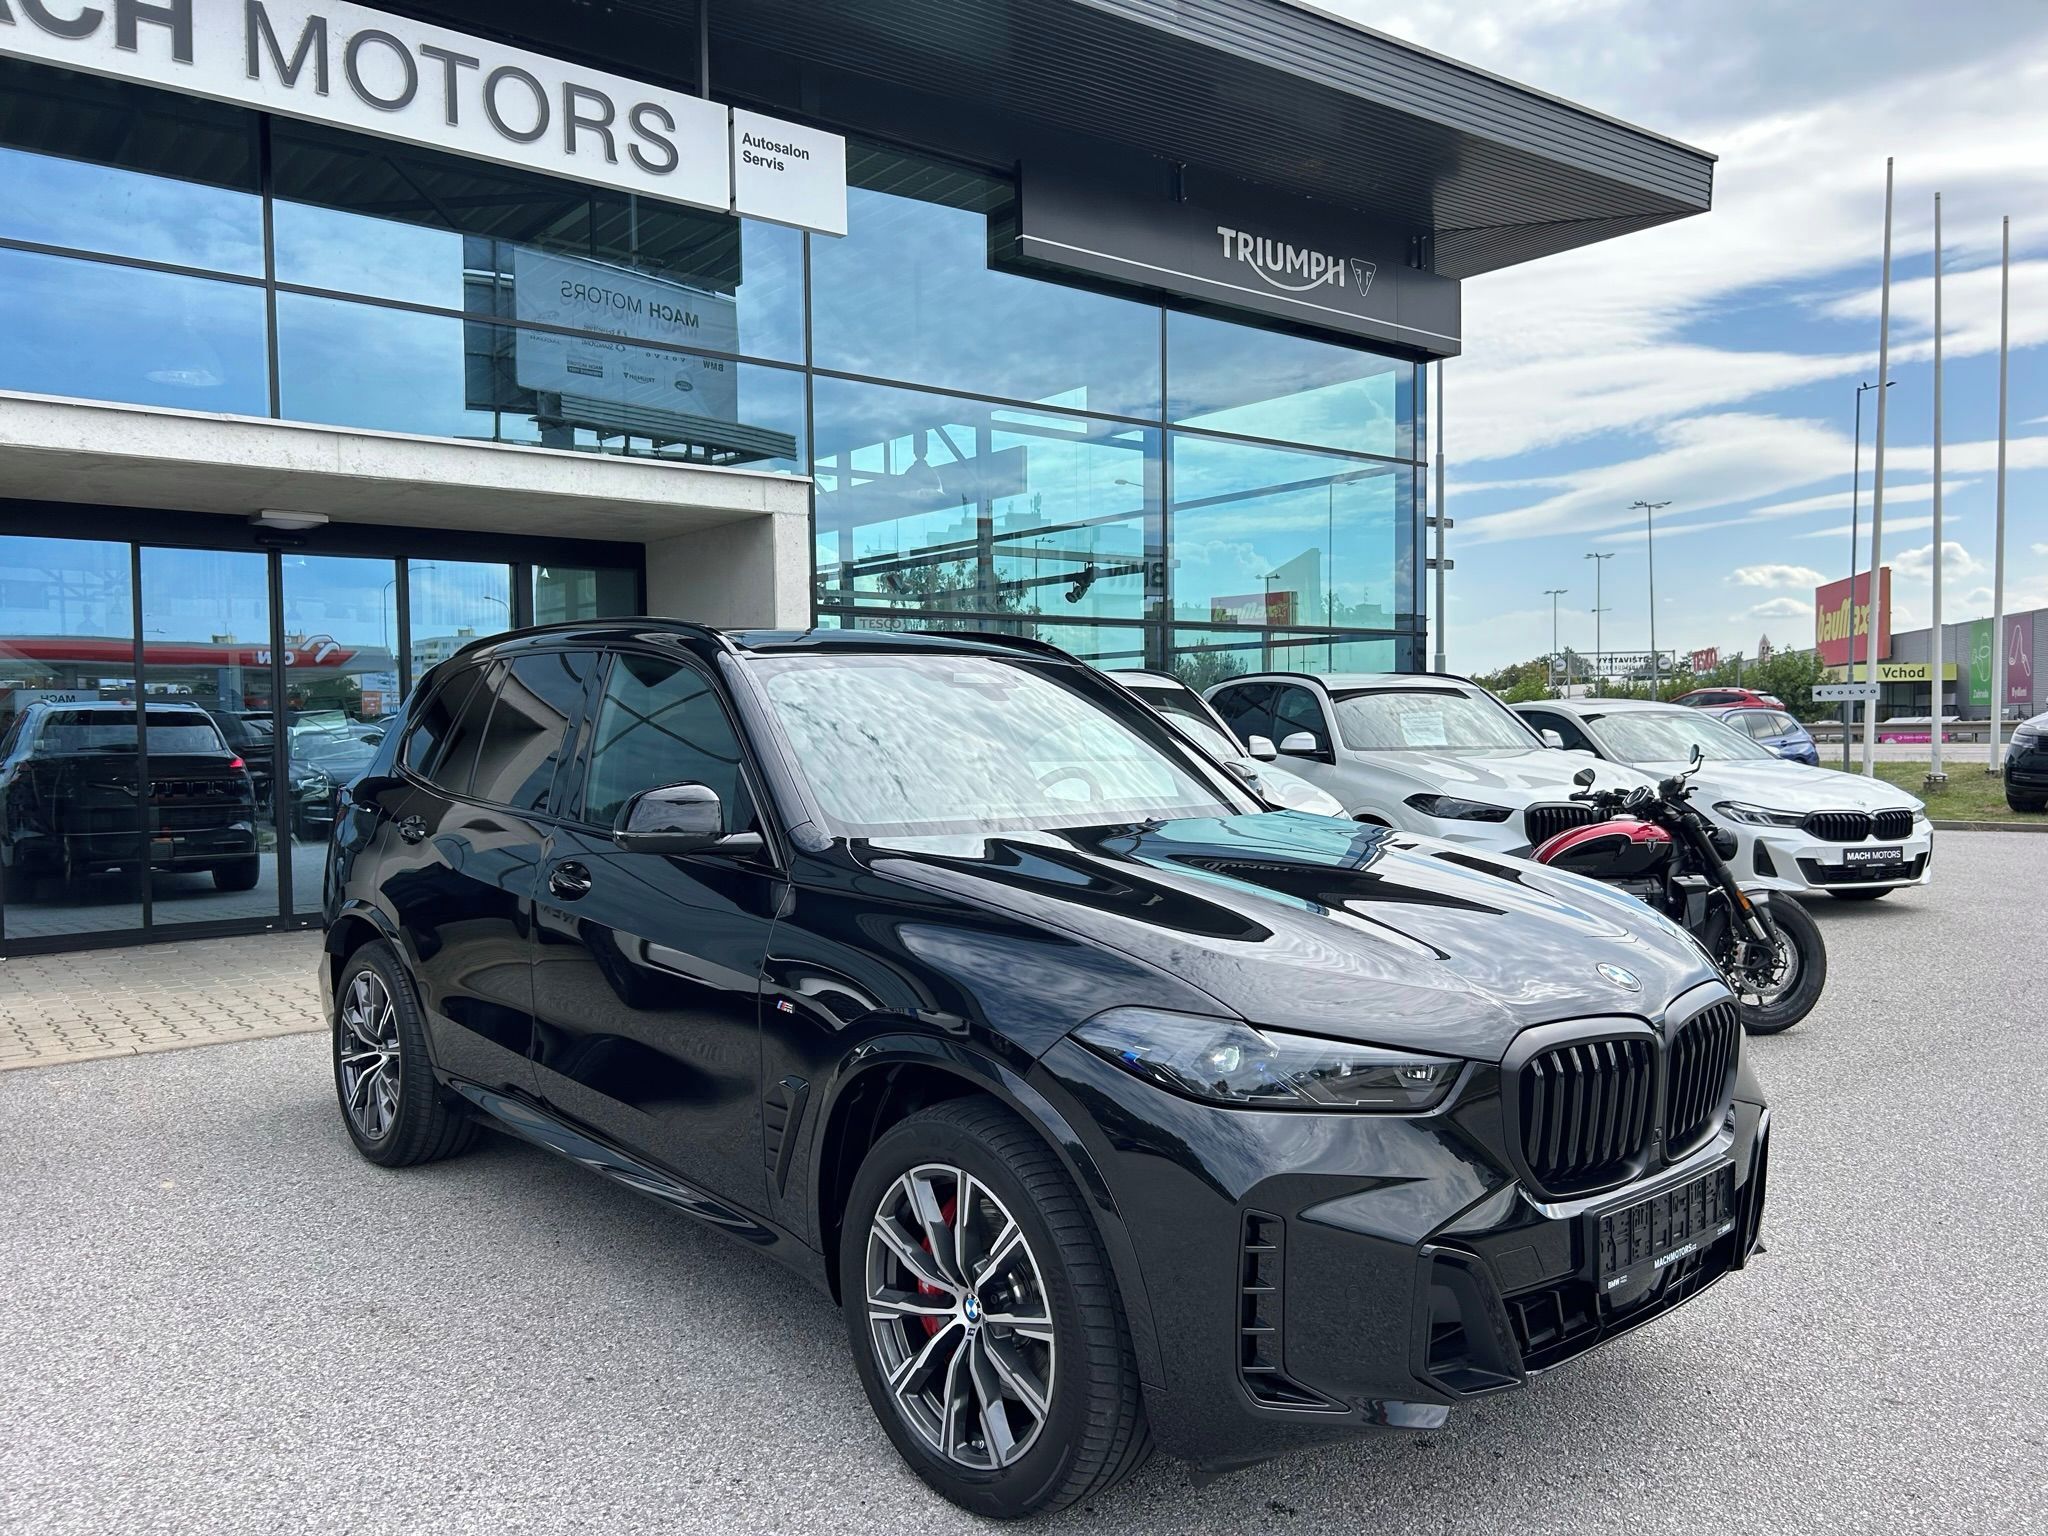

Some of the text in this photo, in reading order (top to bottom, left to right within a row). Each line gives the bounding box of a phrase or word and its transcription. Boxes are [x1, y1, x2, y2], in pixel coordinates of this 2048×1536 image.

[245, 0, 680, 176] MOTORS
[742, 132, 810, 160] Autosalon
[742, 150, 785, 171] Servis
[1216, 225, 1345, 292] TRIUMPH
[1882, 667, 1925, 679] Vchod
[1826, 688, 1877, 696] VOLVO
[1847, 850, 1901, 861] MACH MOTORS
